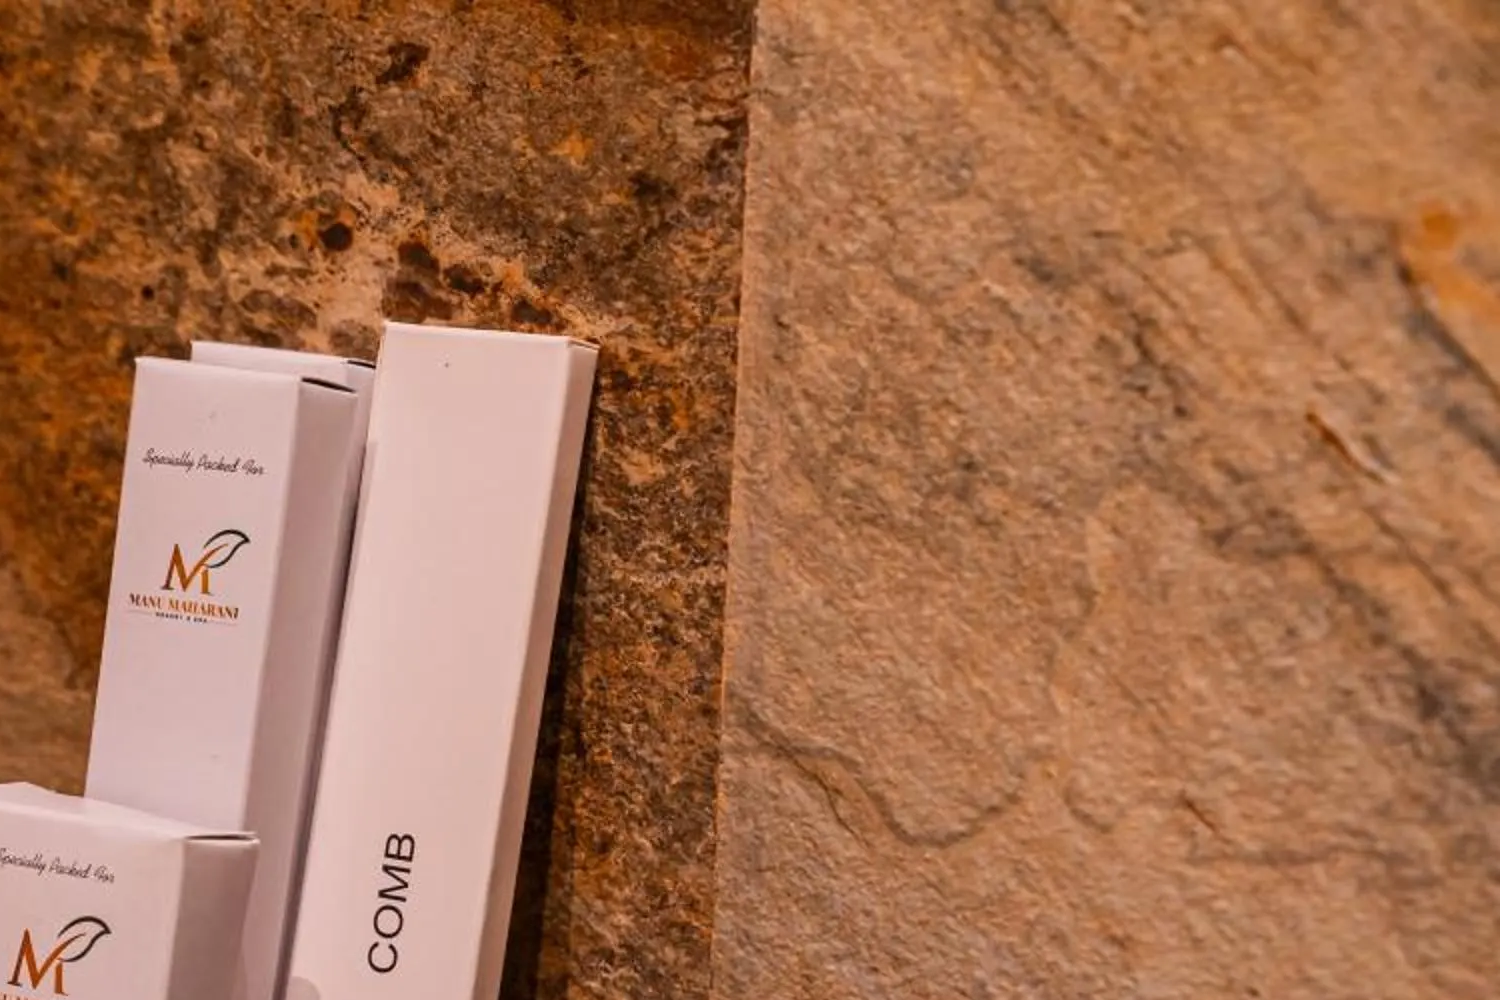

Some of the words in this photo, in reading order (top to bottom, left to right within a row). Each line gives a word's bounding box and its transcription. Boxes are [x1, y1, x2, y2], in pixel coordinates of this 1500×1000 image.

[142, 447, 195, 473] Specially
[196, 453, 241, 473] Packed
[129, 592, 162, 609] MANU
[168, 598, 239, 620] MAHARANI
[48, 856, 92, 879] Packed
[367, 833, 415, 973] COMB
